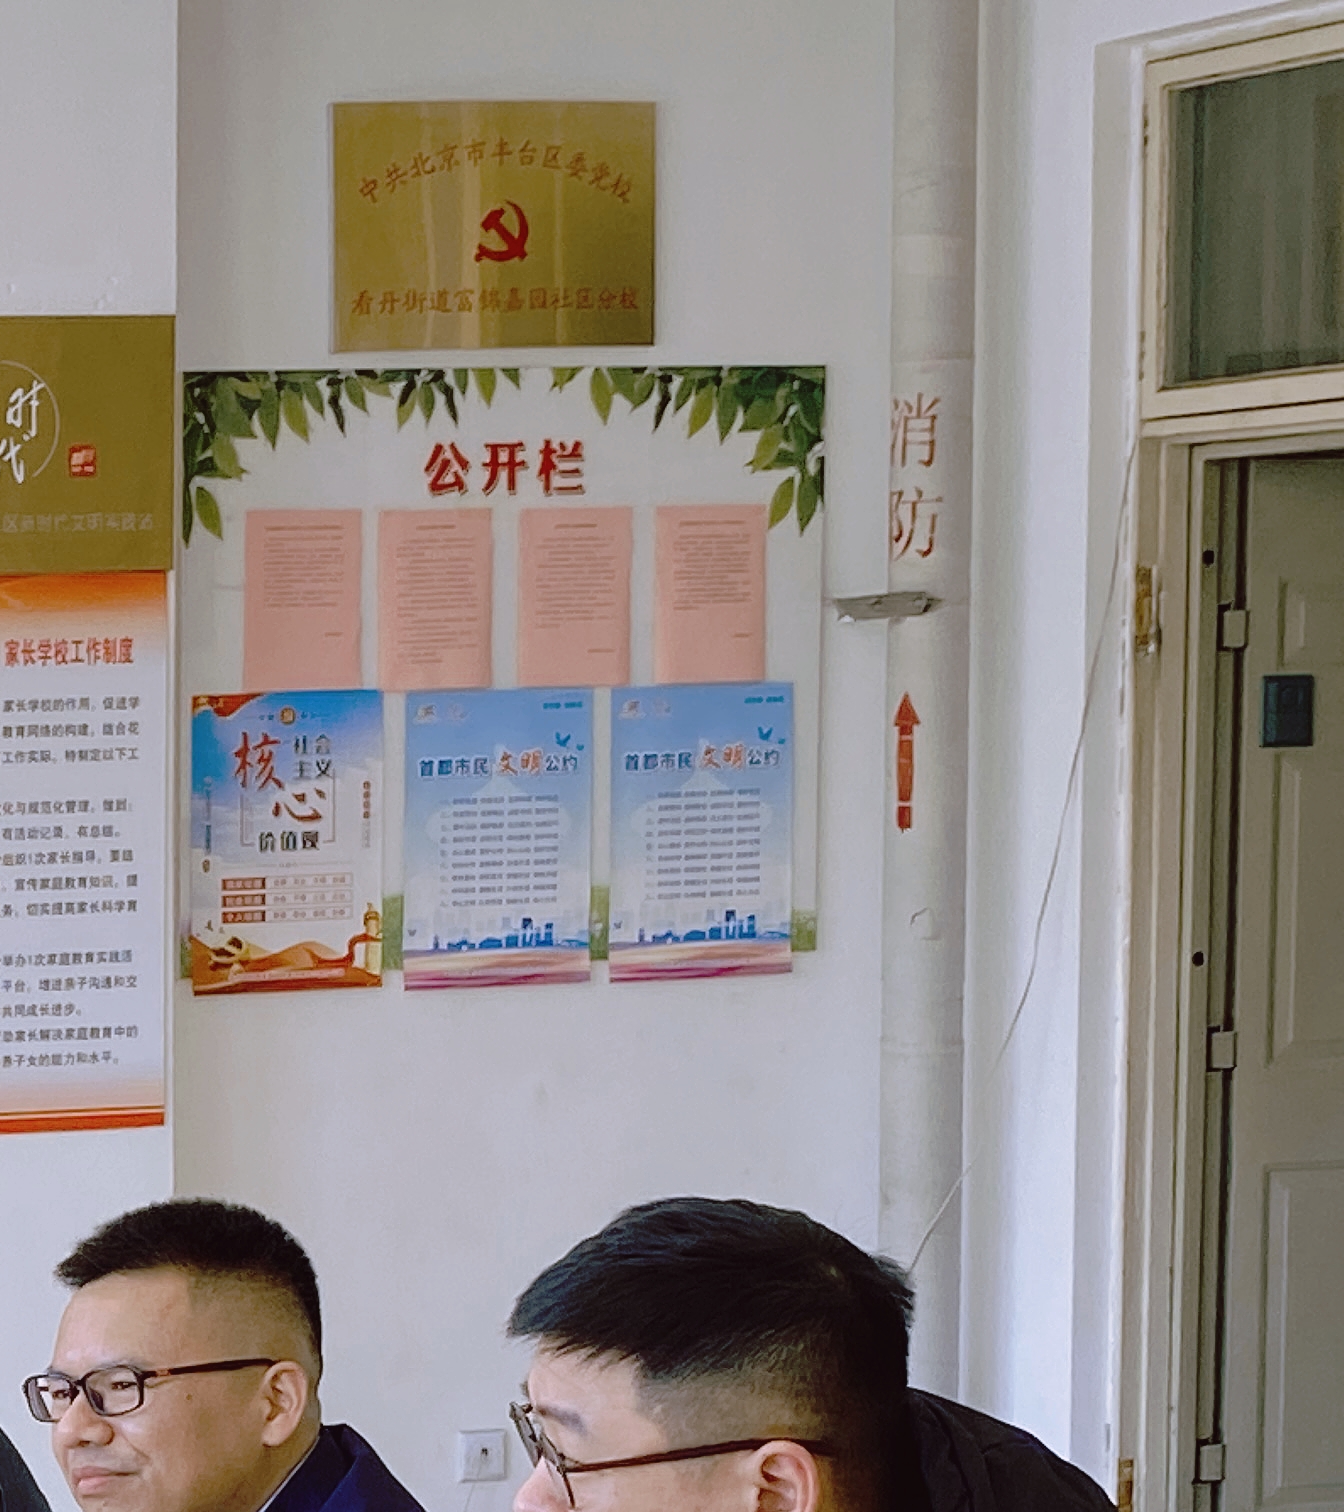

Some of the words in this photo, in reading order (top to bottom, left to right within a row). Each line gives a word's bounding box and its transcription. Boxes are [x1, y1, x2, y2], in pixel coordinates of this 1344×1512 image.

[359, 137, 633, 204] 中共北京市丰台区委党校
[423, 438, 586, 496] 公开栏
[890, 391, 944, 562] 消防
